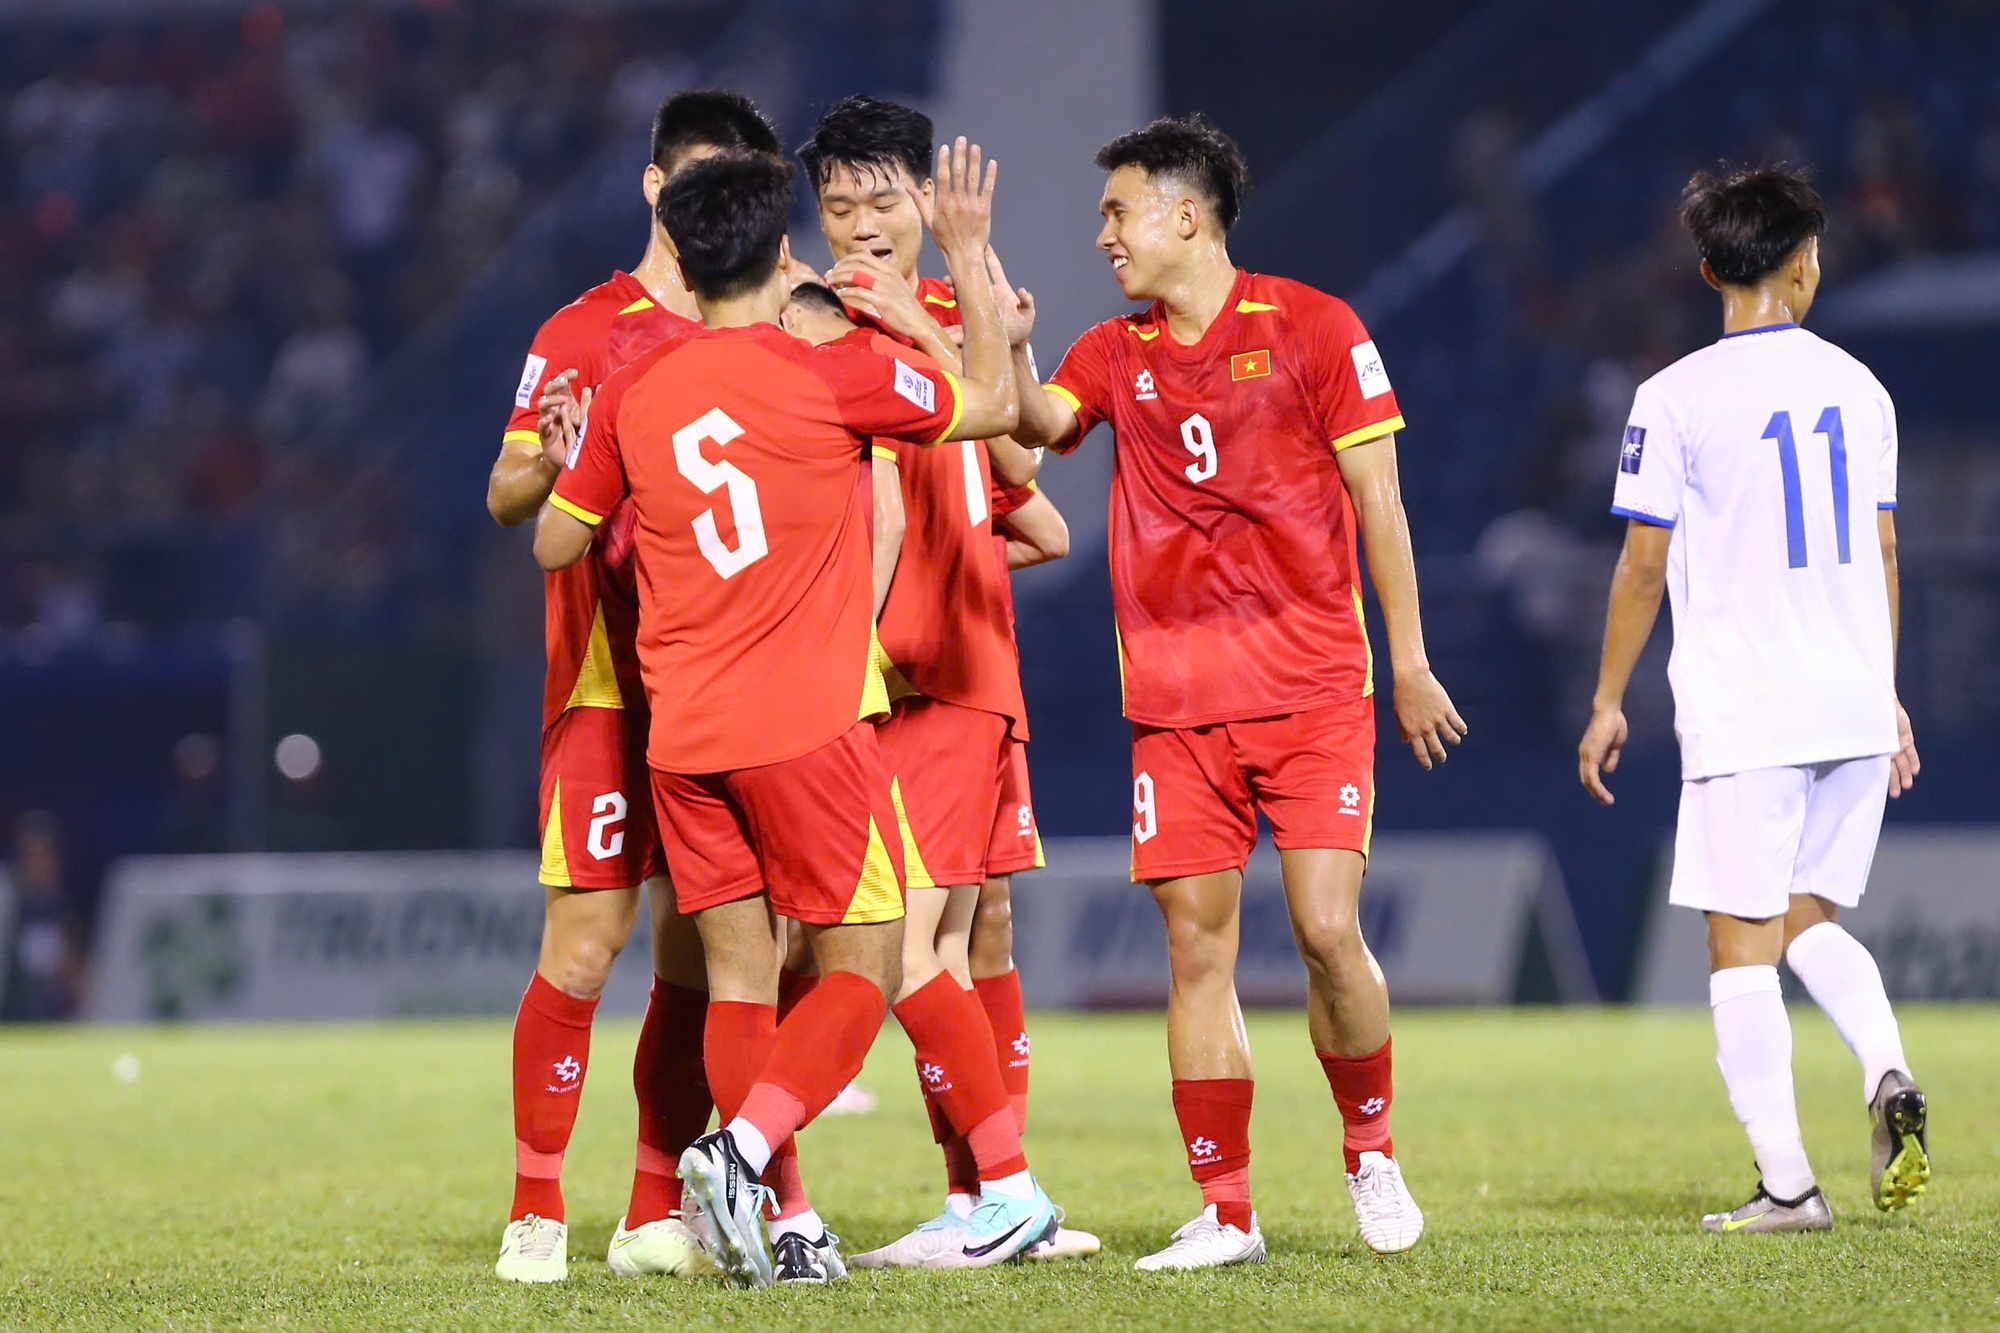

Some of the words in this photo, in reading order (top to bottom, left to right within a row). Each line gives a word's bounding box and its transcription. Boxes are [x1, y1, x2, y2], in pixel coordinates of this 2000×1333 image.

[1361, 360, 1380, 378] AFC
[1180, 412, 1219, 484] 9
[672, 407, 768, 580] 5
[1760, 406, 1851, 569] 11
[586, 791, 628, 860] 2
[1134, 770, 1158, 845] 9
